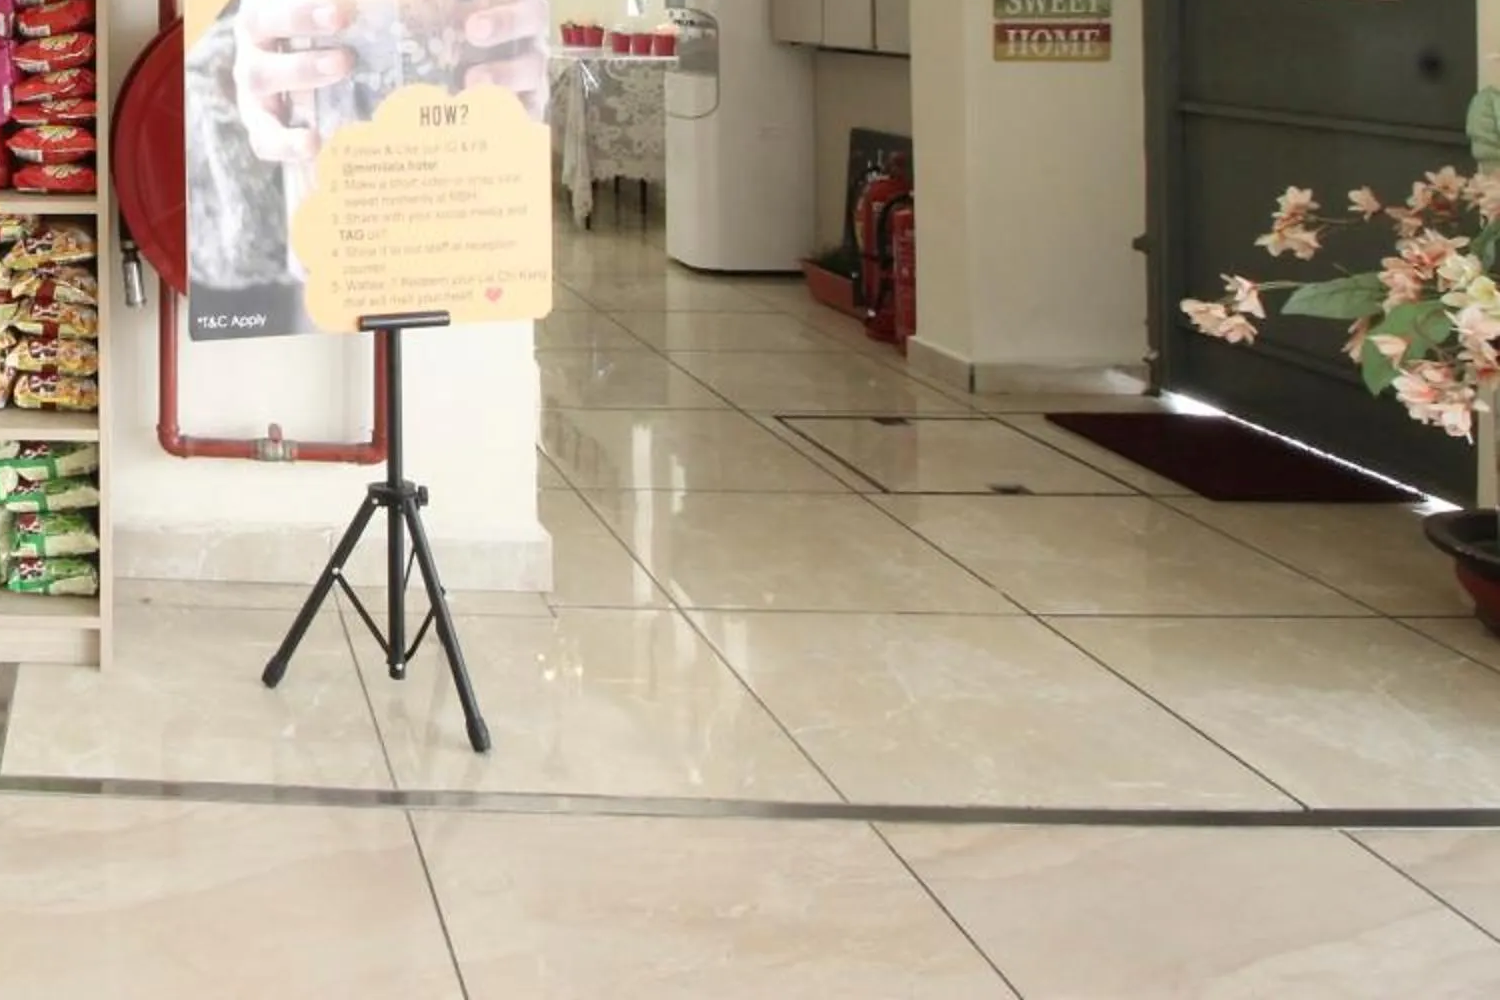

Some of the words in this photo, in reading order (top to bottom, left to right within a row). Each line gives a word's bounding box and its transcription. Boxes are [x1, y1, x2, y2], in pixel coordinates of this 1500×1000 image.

[1005, 29, 1101, 58] HOME
[419, 104, 470, 127] HOW?
[339, 229, 364, 241] TAG
[231, 313, 267, 330] Apply
